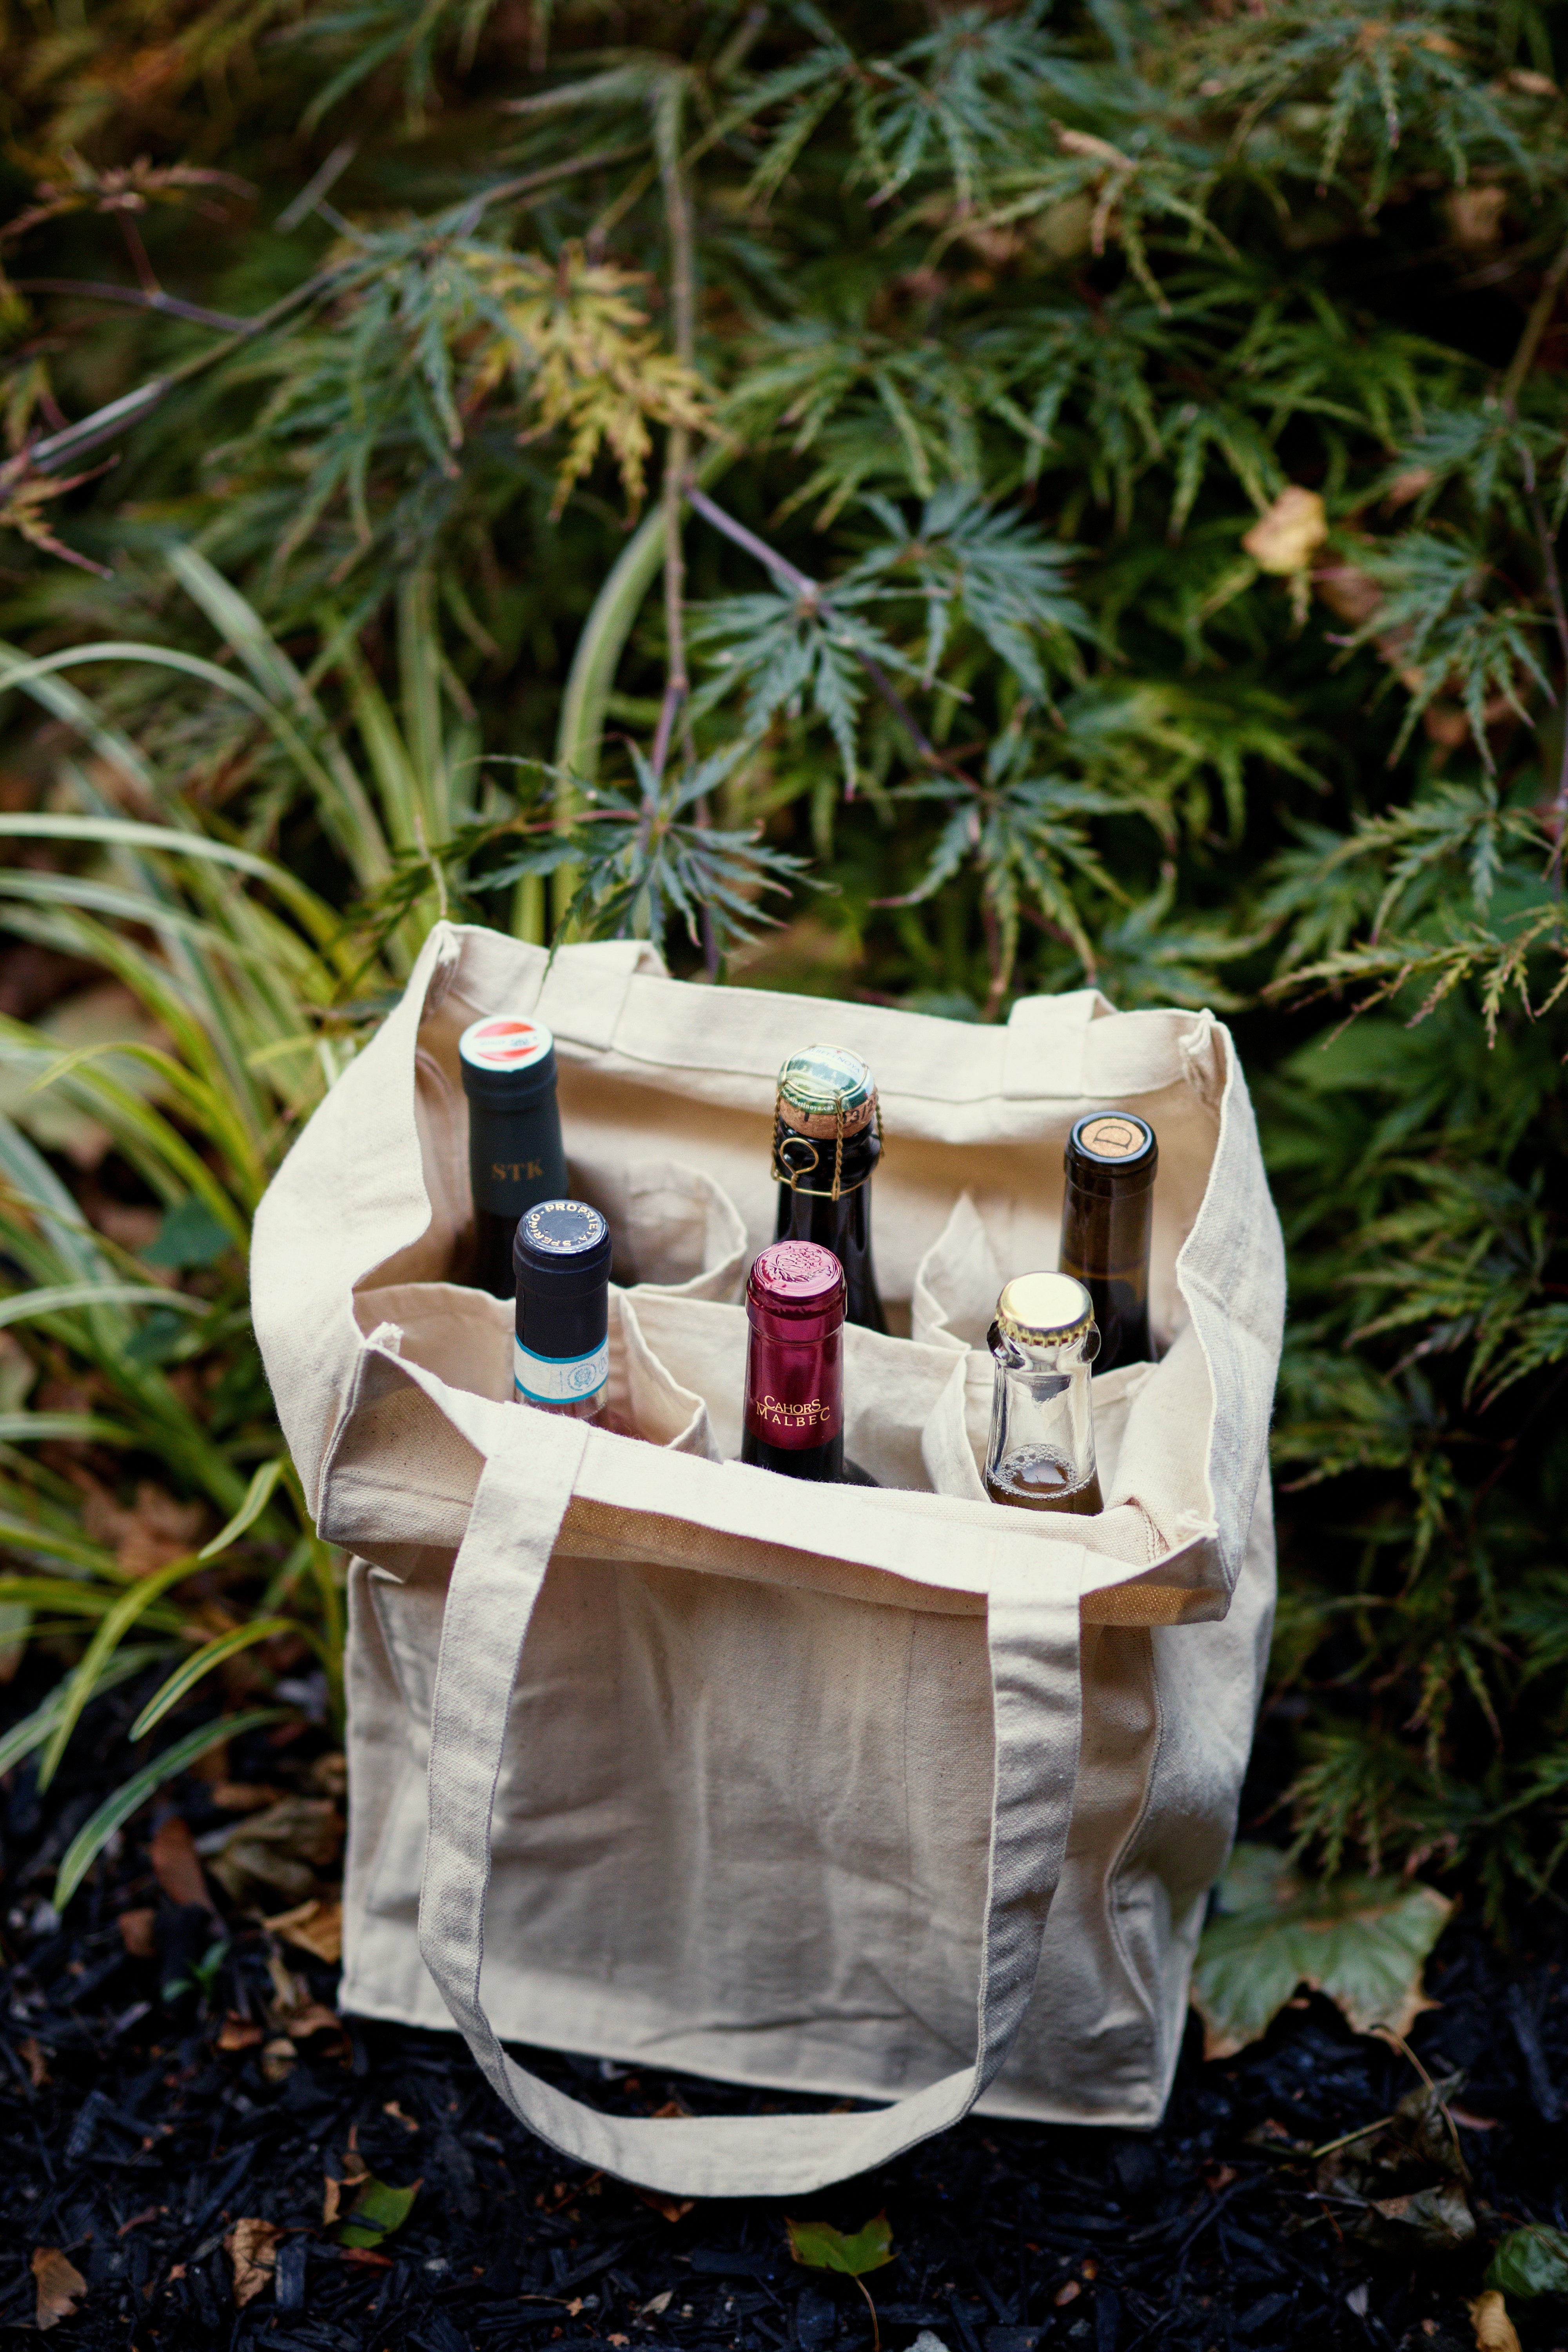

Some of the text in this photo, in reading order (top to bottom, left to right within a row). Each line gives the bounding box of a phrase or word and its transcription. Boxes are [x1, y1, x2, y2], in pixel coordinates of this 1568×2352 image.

[837, 1056, 860, 1073] NOYA
[1093, 1125, 1132, 1150] D
[492, 1158, 543, 1181] STK
[529, 1213, 572, 1247] SPERINO
[756, 1401, 830, 1426] MALBEC
[764, 1395, 821, 1414] CAHORS
